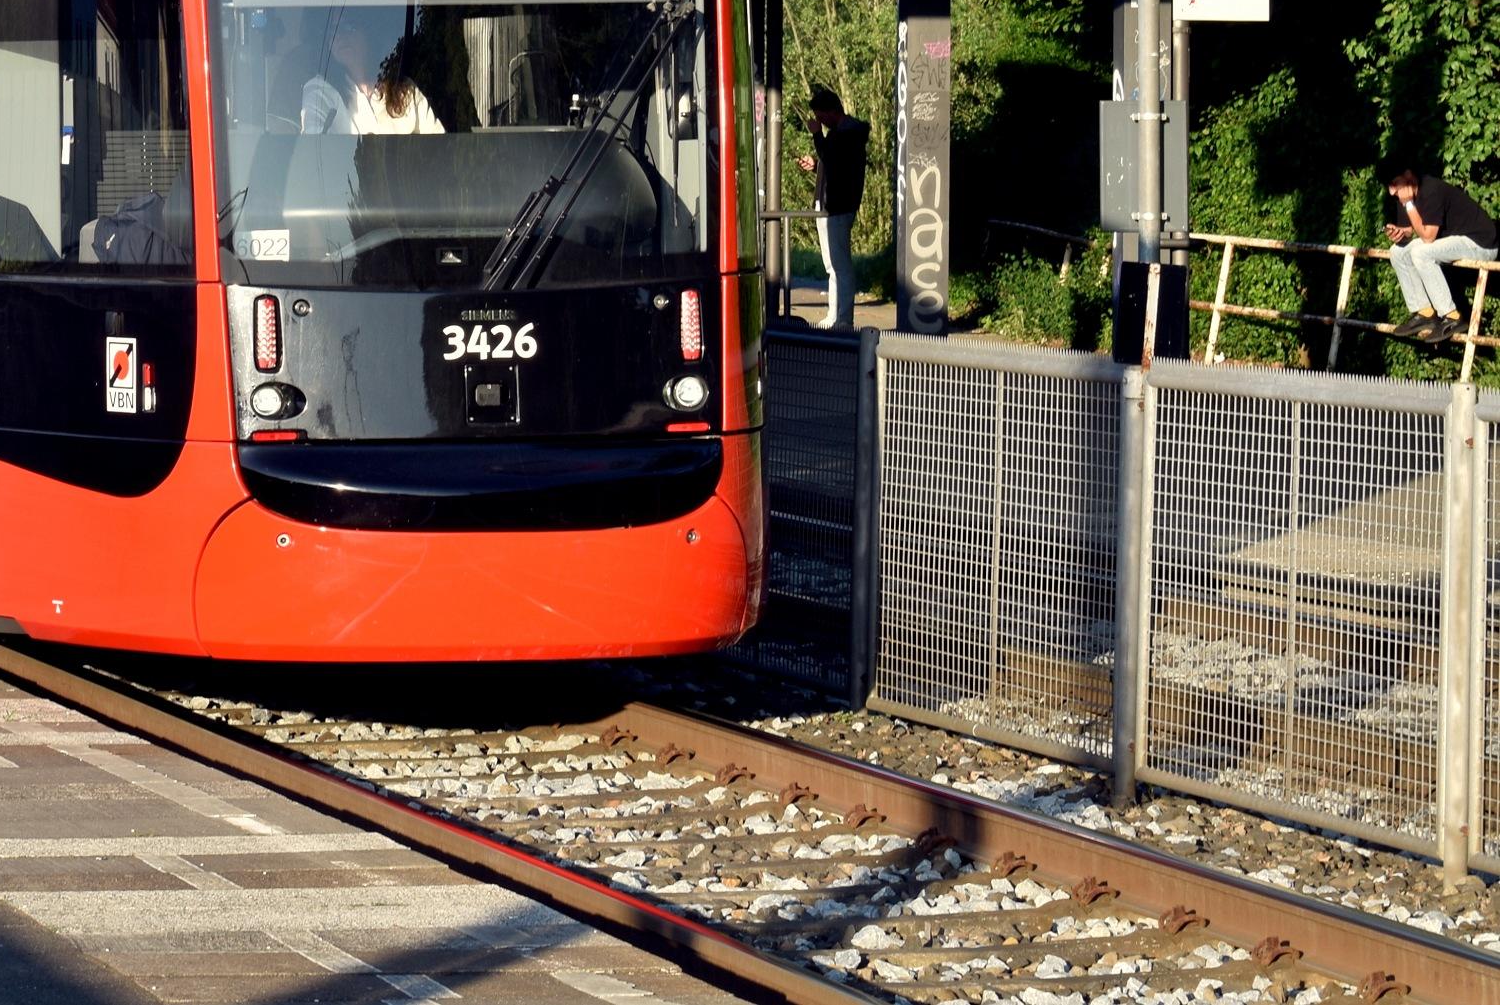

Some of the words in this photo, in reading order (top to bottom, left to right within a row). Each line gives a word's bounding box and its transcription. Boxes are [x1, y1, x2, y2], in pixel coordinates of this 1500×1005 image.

[238, 238, 289, 258] 6022
[443, 322, 538, 360] 3426
[109, 392, 134, 409] VBN
